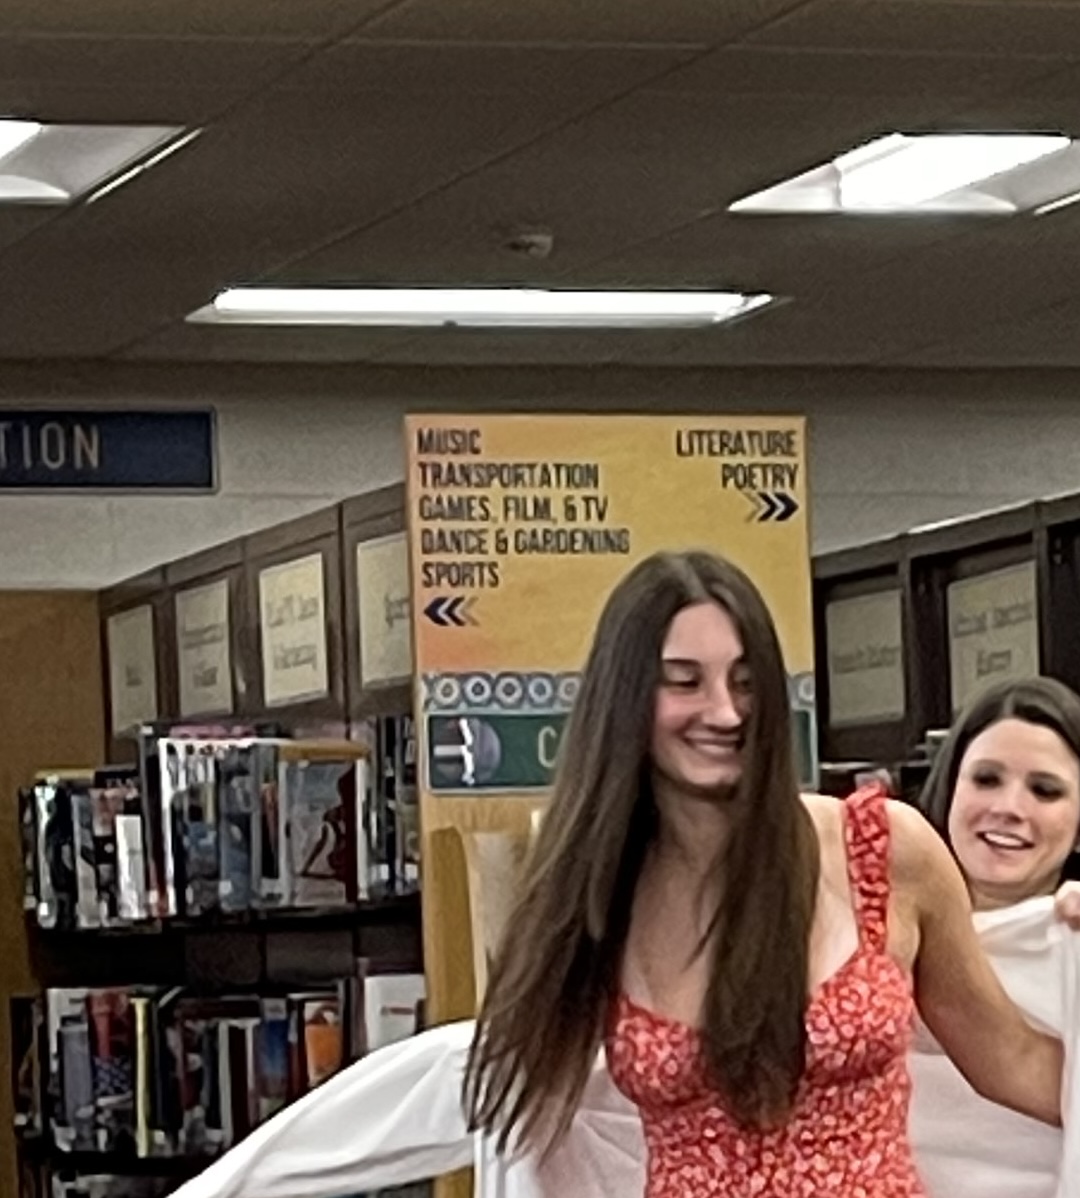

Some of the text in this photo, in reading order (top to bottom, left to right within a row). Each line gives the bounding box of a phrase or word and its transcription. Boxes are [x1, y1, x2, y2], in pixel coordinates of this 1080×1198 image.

[416, 427, 482, 455] MUSIC
[676, 429, 798, 457] LITERATURE
[417, 461, 600, 489] TRANSPORTATION
[721, 463, 799, 490] POETRY
[419, 493, 499, 524] GAMES,
[502, 494, 559, 524] FILM,
[582, 494, 609, 522] TV
[421, 527, 630, 554] DANCE & GARDENING
[421, 561, 500, 589] SPORTS
